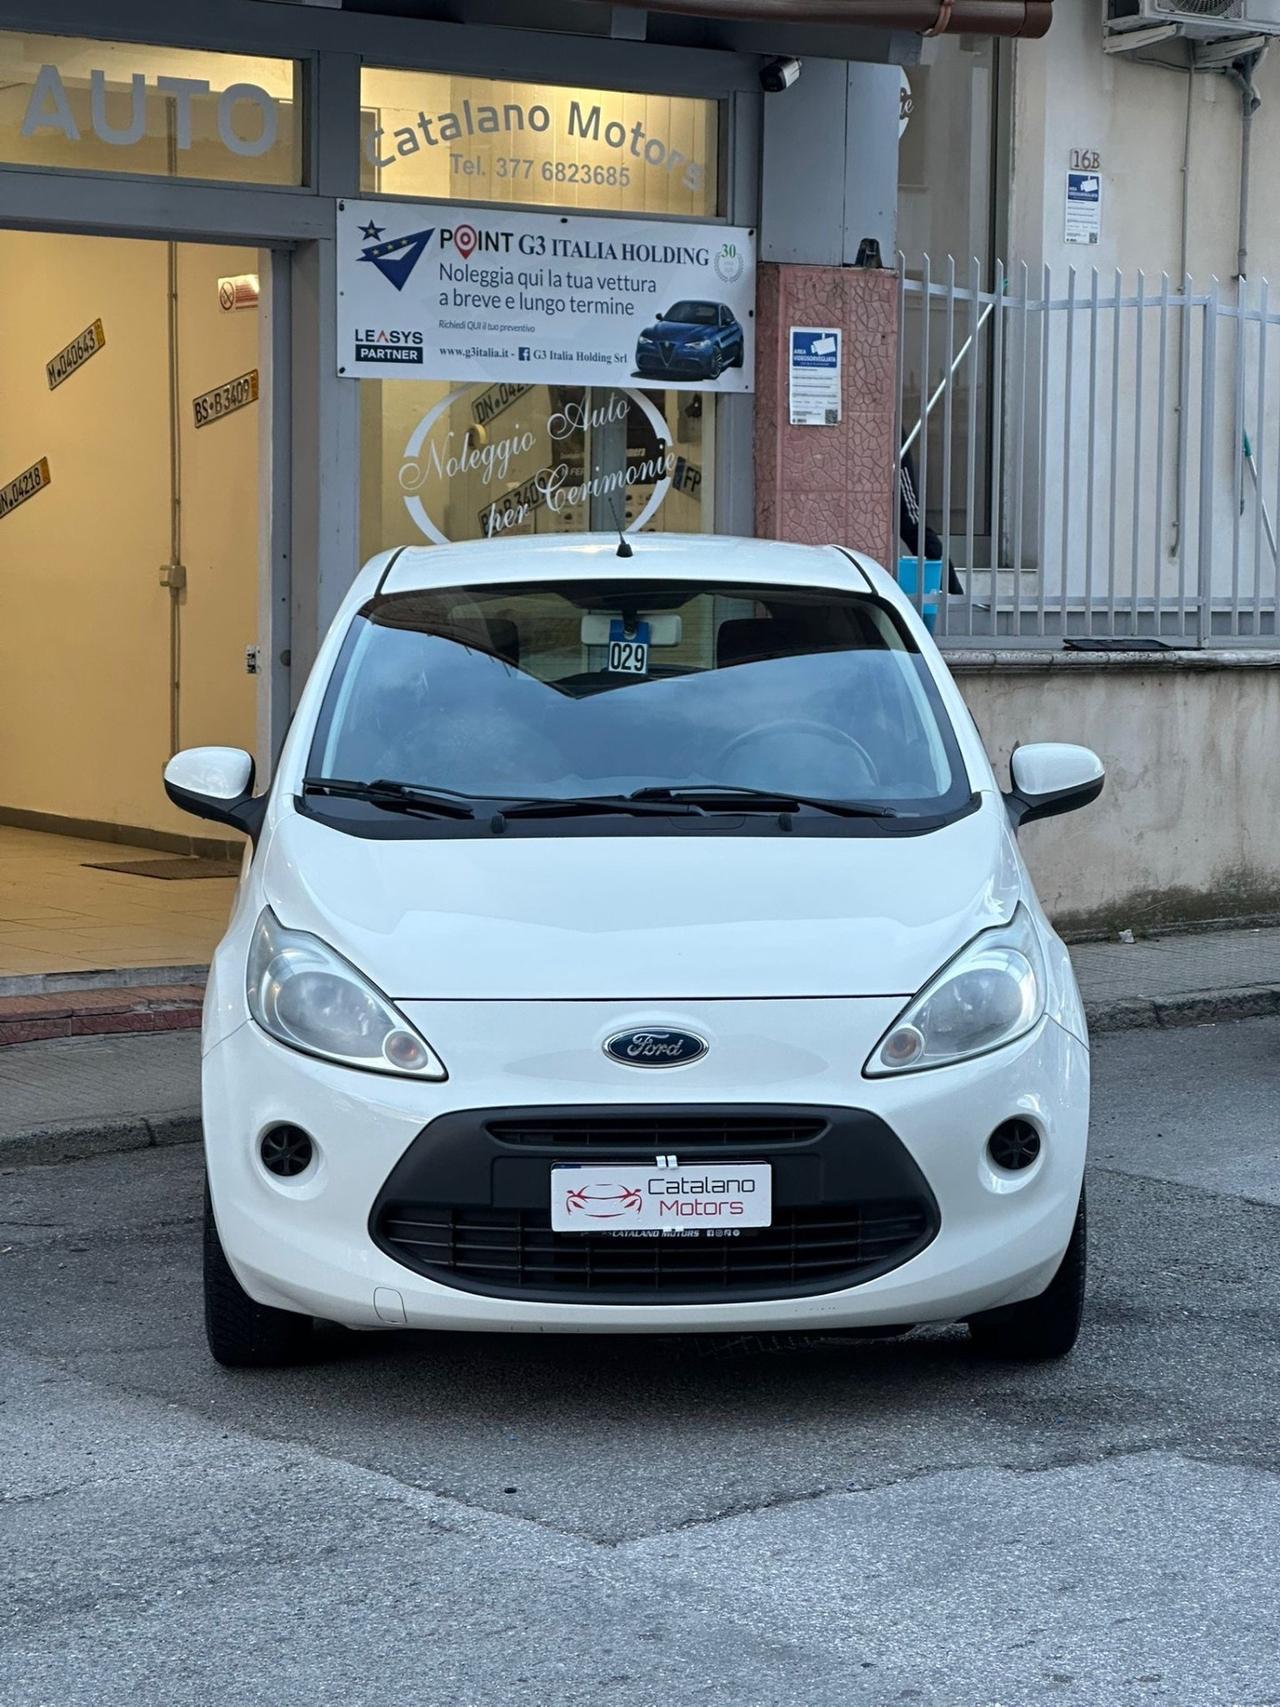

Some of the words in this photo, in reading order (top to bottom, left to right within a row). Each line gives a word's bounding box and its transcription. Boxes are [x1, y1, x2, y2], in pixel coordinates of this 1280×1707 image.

[20, 64, 278, 157] AUTO
[364, 99, 550, 168] Catalano
[567, 100, 705, 193] Motors
[450, 153, 486, 176] Tel.
[495, 157, 533, 180] 377
[541, 161, 631, 187] 6823685
[1073, 149, 1100, 170] 16B
[518, 234, 546, 256] G3
[551, 239, 617, 261] ITALIA
[622, 243, 710, 266] HOLDING
[721, 243, 736, 258] 30
[440, 262, 514, 288] Noleggia
[518, 269, 543, 289] qui
[548, 269, 562, 287] la
[566, 271, 593, 289] tua
[597, 275, 657, 293] vettura
[439, 292, 449, 306] a
[453, 287, 501, 309] breve
[505, 296, 515, 310] e
[519, 291, 566, 316] lungo
[569, 296, 635, 316] termine
[355, 328, 423, 345] LEASYS
[439, 319, 466, 330] Richiedi
[467, 320, 481, 331] QUI
[487, 321, 499, 331] tuo
[500, 322, 535, 333] preventivo
[360, 348, 418, 361] PARTNER
[439, 347, 509, 359] www.g3italia.it
[533, 349, 547, 360] G3
[550, 350, 573, 361] Italia
[576, 351, 612, 364] Holding
[614, 353, 627, 363] Srl
[398, 423, 536, 490] Noleggio
[547, 391, 631, 440] Auto
[487, 502, 529, 538] per
[534, 451, 676, 515] Cerimonie
[610, 642, 645, 672] 029
[627, 1033, 683, 1056] Ford
[648, 1176, 755, 1195] Catalano
[659, 1198, 744, 1216] Motors
